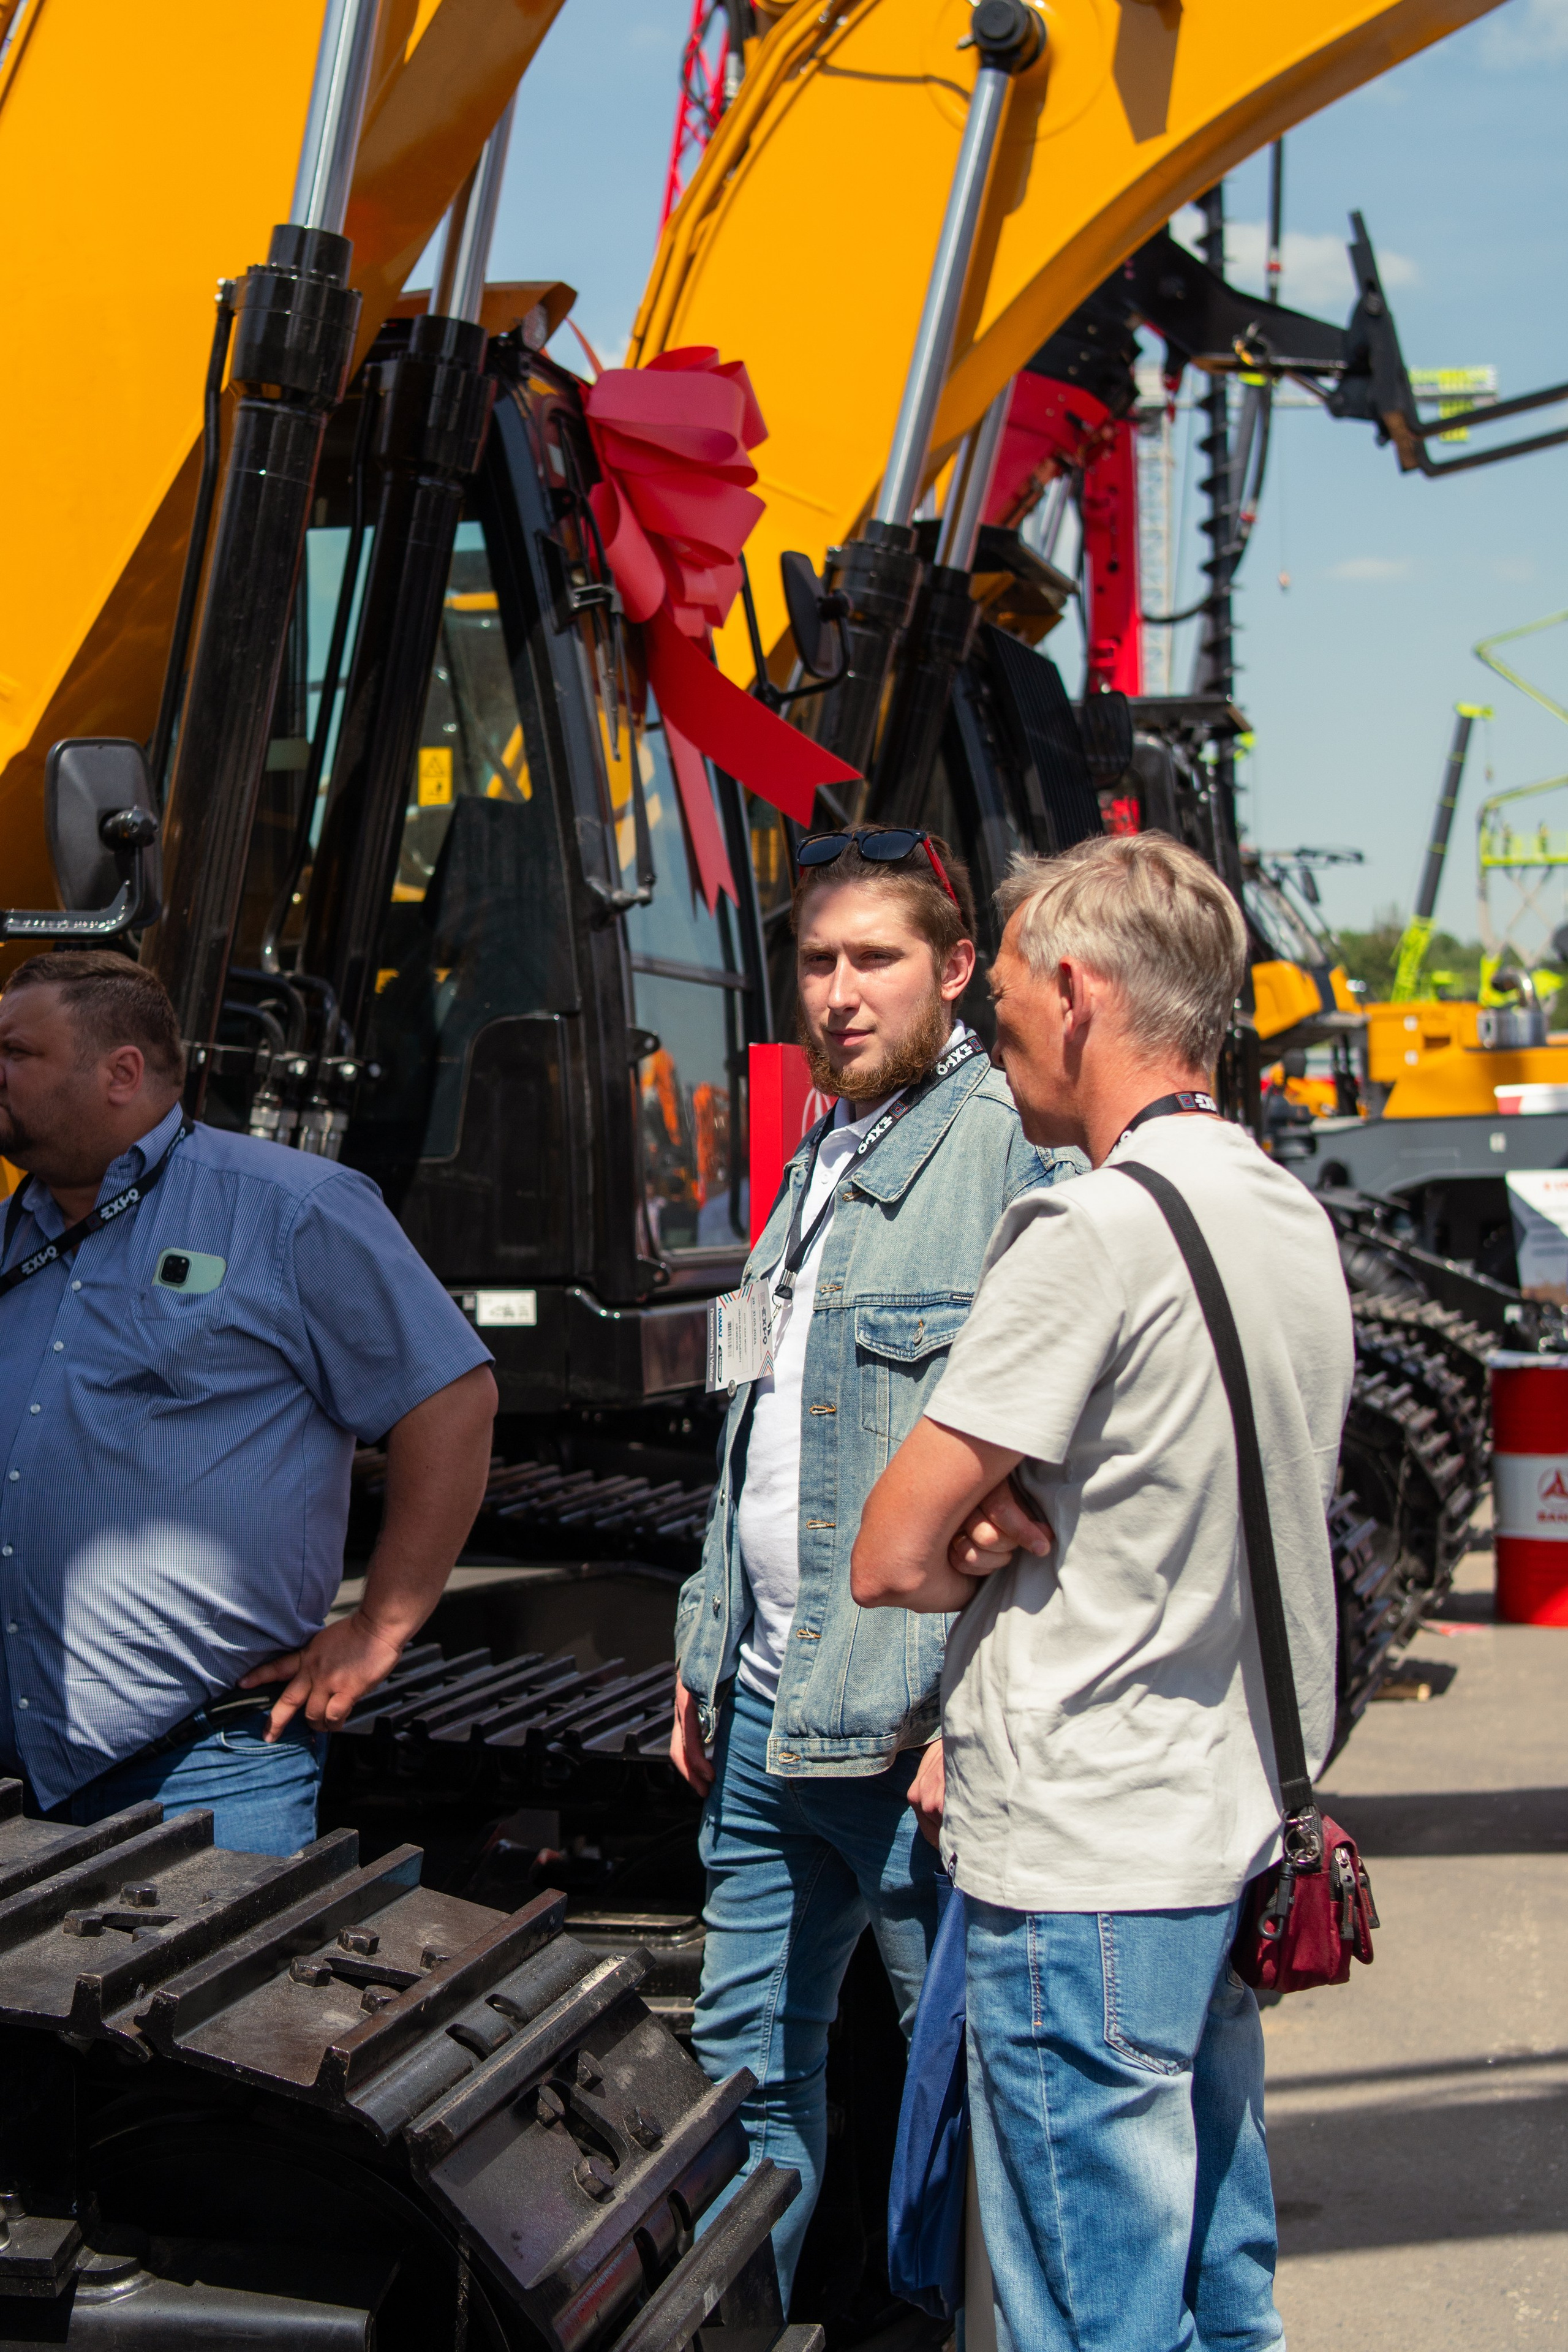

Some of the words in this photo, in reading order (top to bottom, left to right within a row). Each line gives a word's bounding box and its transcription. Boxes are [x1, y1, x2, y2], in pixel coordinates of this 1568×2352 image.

[937, 1043, 973, 1075] EXPO
[858, 1116, 892, 1154] EXPO
[100, 1188, 140, 1220] EXPO
[21, 1246, 59, 1275] EXPO
